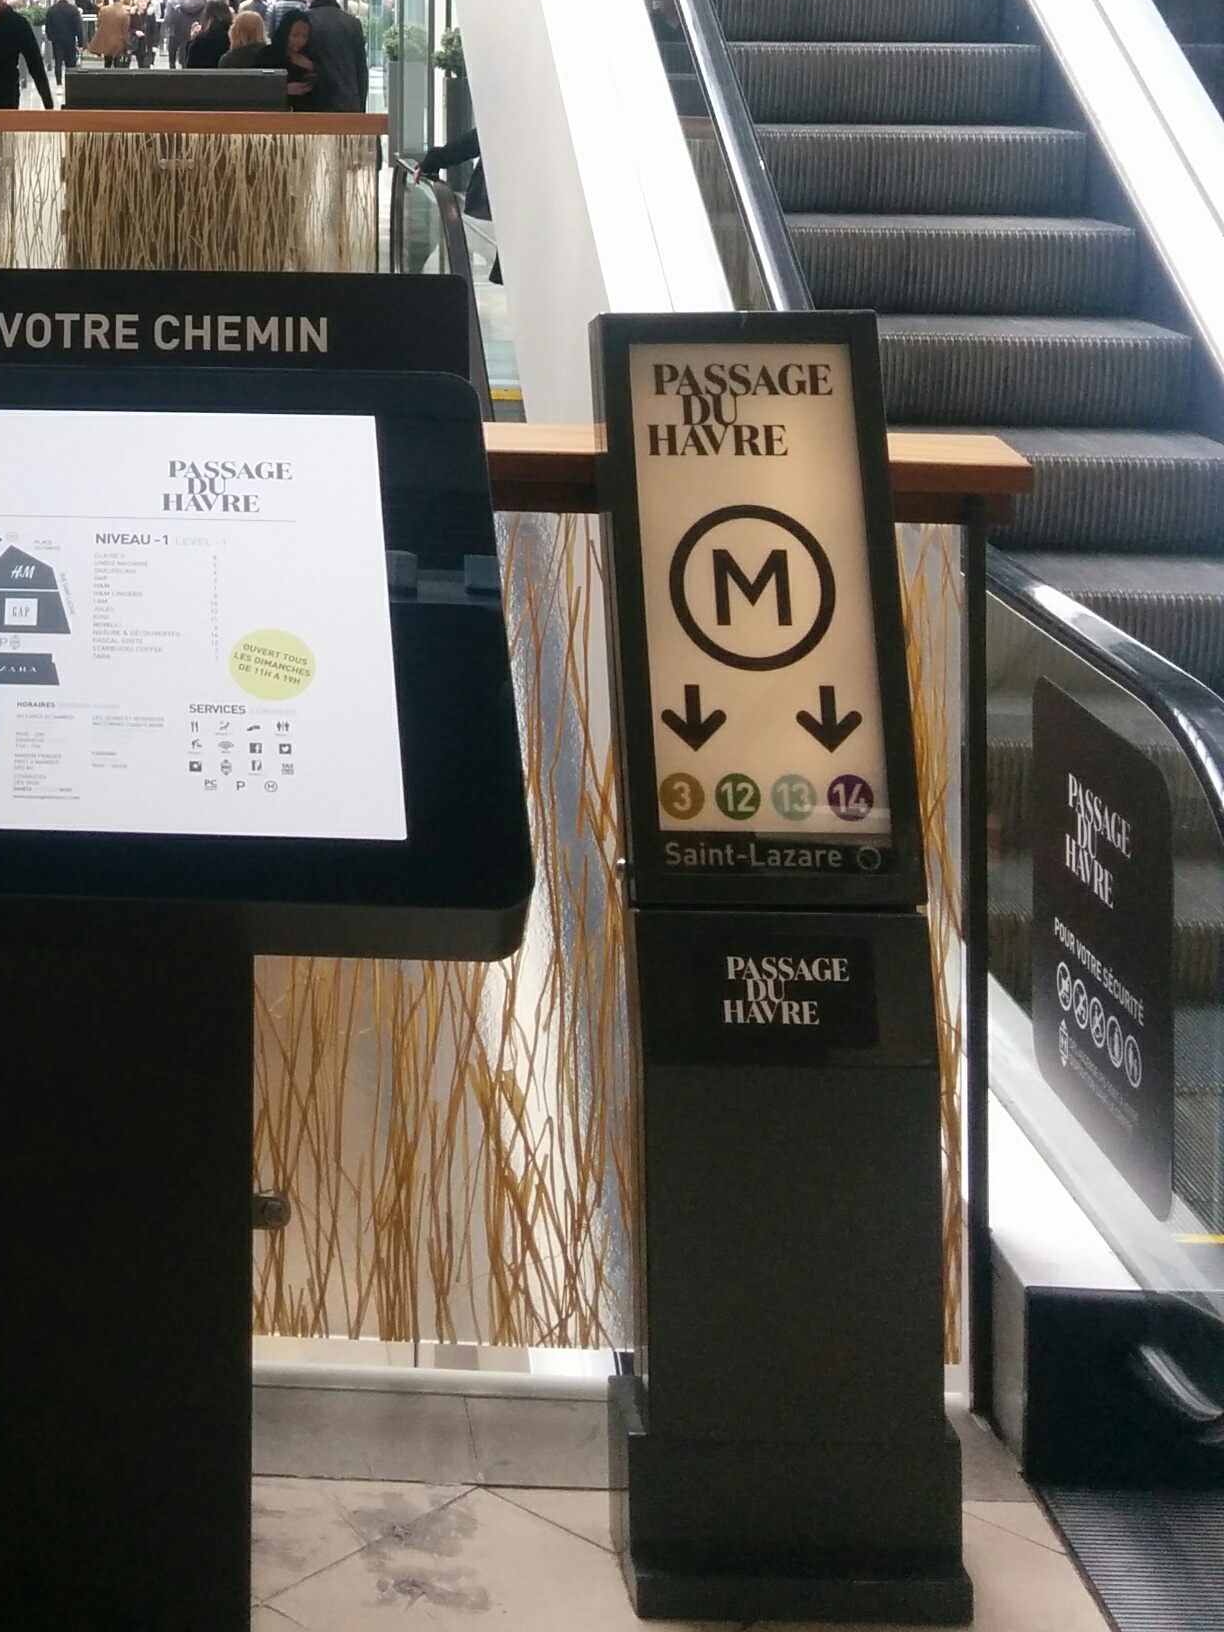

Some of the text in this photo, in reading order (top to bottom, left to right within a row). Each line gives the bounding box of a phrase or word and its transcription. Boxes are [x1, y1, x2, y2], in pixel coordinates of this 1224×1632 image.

[152, 314, 329, 353] CHEMIN
[653, 363, 833, 396] PASSAGE
[682, 394, 738, 425] DU
[648, 424, 789, 457] HAVRE
[169, 460, 293, 480] PASSAGE
[188, 477, 226, 495] DU
[163, 493, 260, 513] HAVRE
[95, 533, 151, 545] NIVEAU
[10, 565, 36, 579] H&M
[710, 548, 794, 627] M
[12, 606, 30, 618] GAP
[233, 651, 311, 677] LES DIMANCHES
[243, 643, 308, 666] OUVERT TOUS
[0, 665, 37, 673] ZARA
[238, 663, 252, 673] DE
[254, 667, 271, 678] 11H
[283, 674, 301, 685] 19H
[16, 701, 56, 709] HORAIRES
[189, 703, 247, 715] SERVICES
[236, 780, 246, 791] P
[672, 781, 868, 814] 3 12 13 14
[1068, 772, 1132, 860] PASSAGE
[1077, 811, 1098, 860] DU
[665, 842, 843, 868] Saint-Lazare
[1065, 833, 1114, 910] HAVRE
[726, 956, 850, 982] PASSAGE
[1054, 917, 1145, 1028] POUR VOTRE SÉCURITÉ
[746, 978, 786, 1003] DU
[723, 999, 820, 1025] HAVRE
